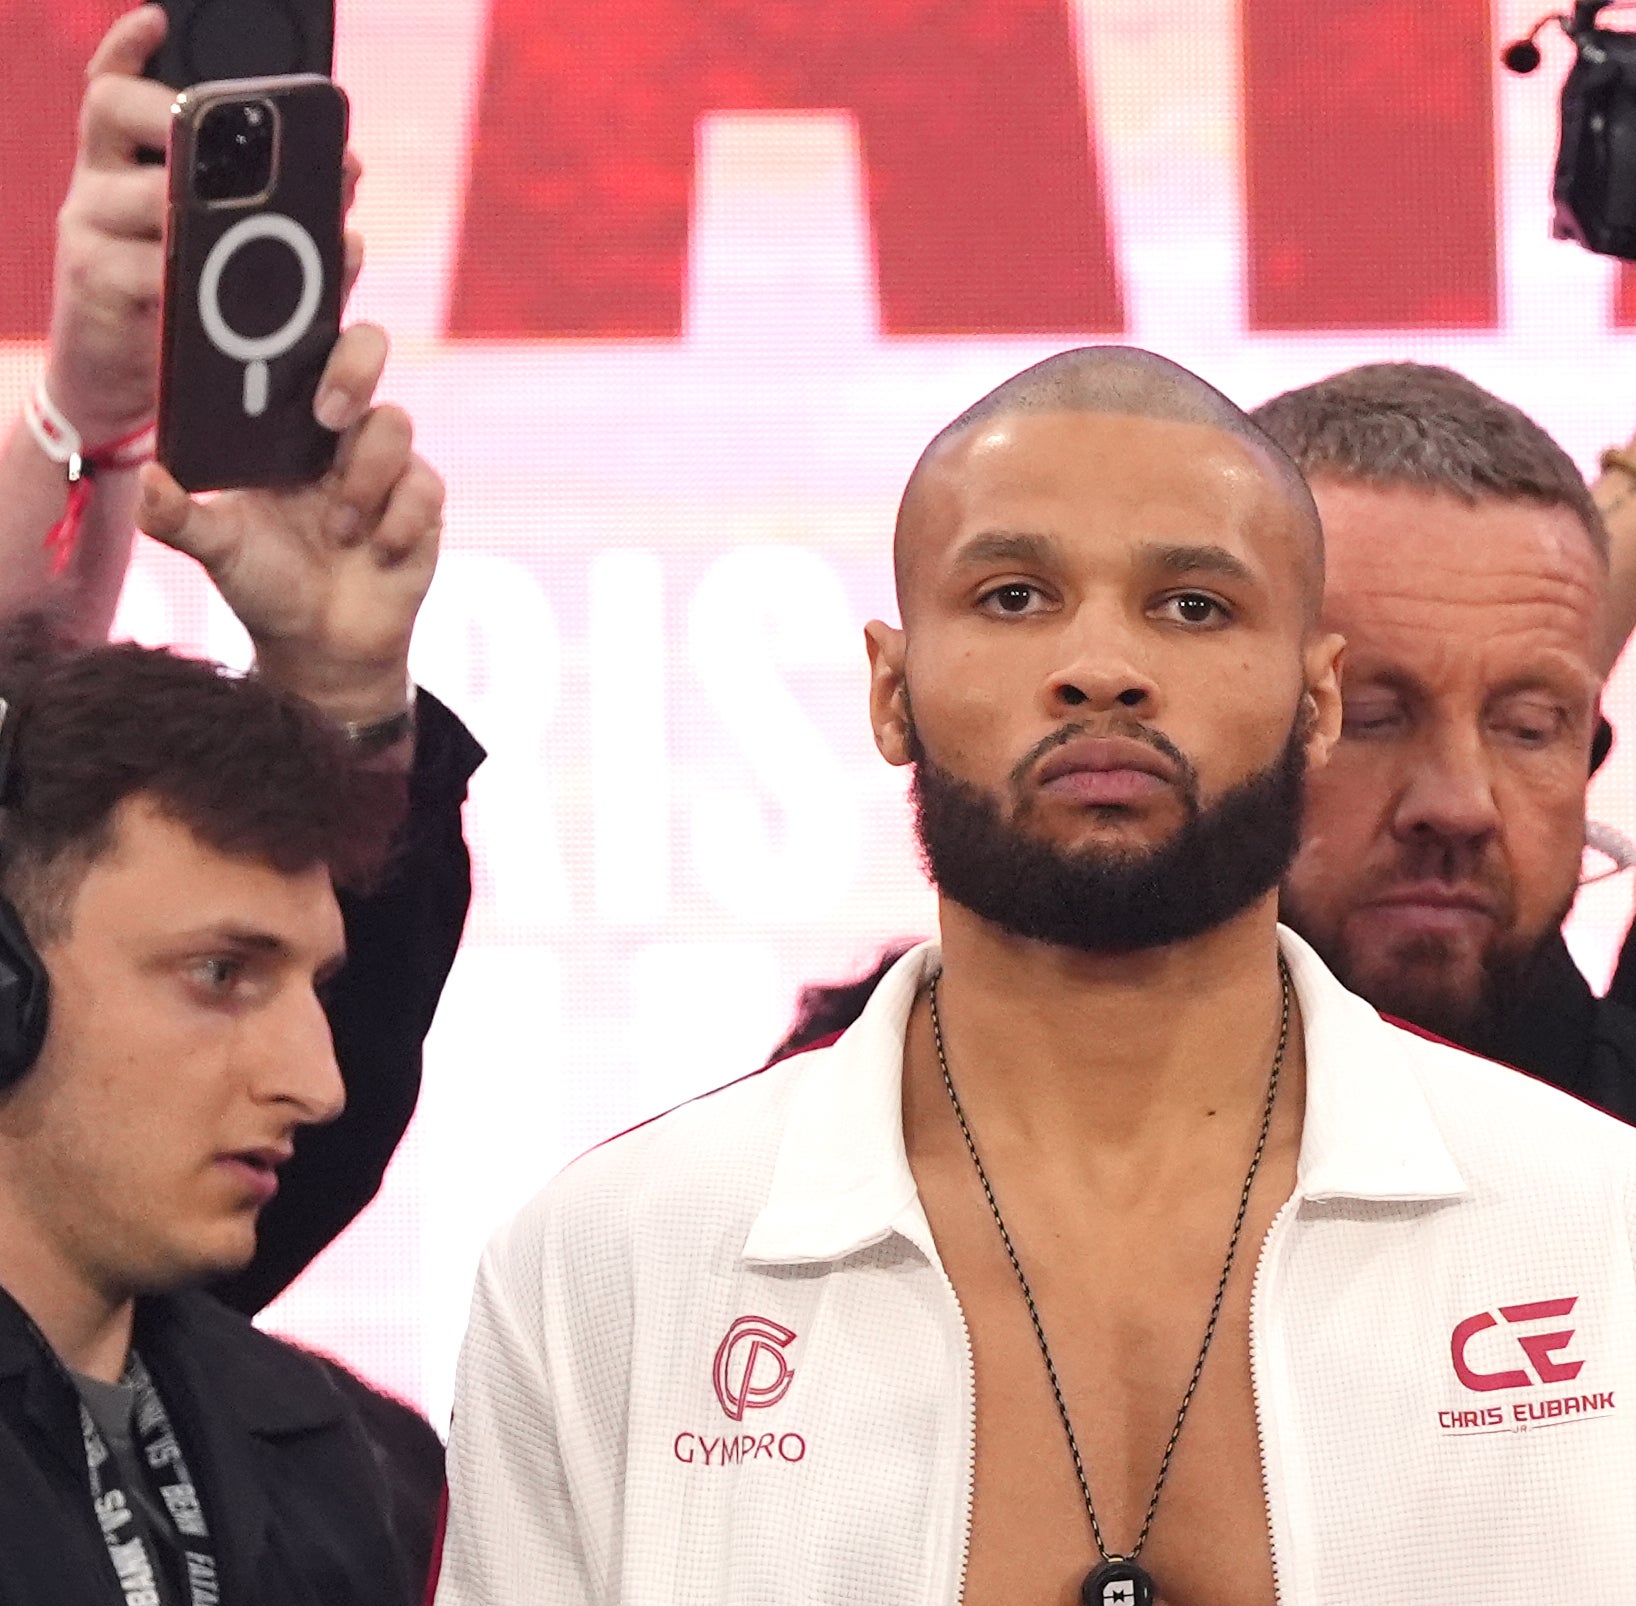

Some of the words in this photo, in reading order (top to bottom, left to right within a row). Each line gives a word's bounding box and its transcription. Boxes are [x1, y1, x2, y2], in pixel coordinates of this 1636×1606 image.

[1438, 1406, 1504, 1429] CHRIS
[1513, 1391, 1616, 1423] EUBANK
[674, 1432, 806, 1467] GYMPRO
